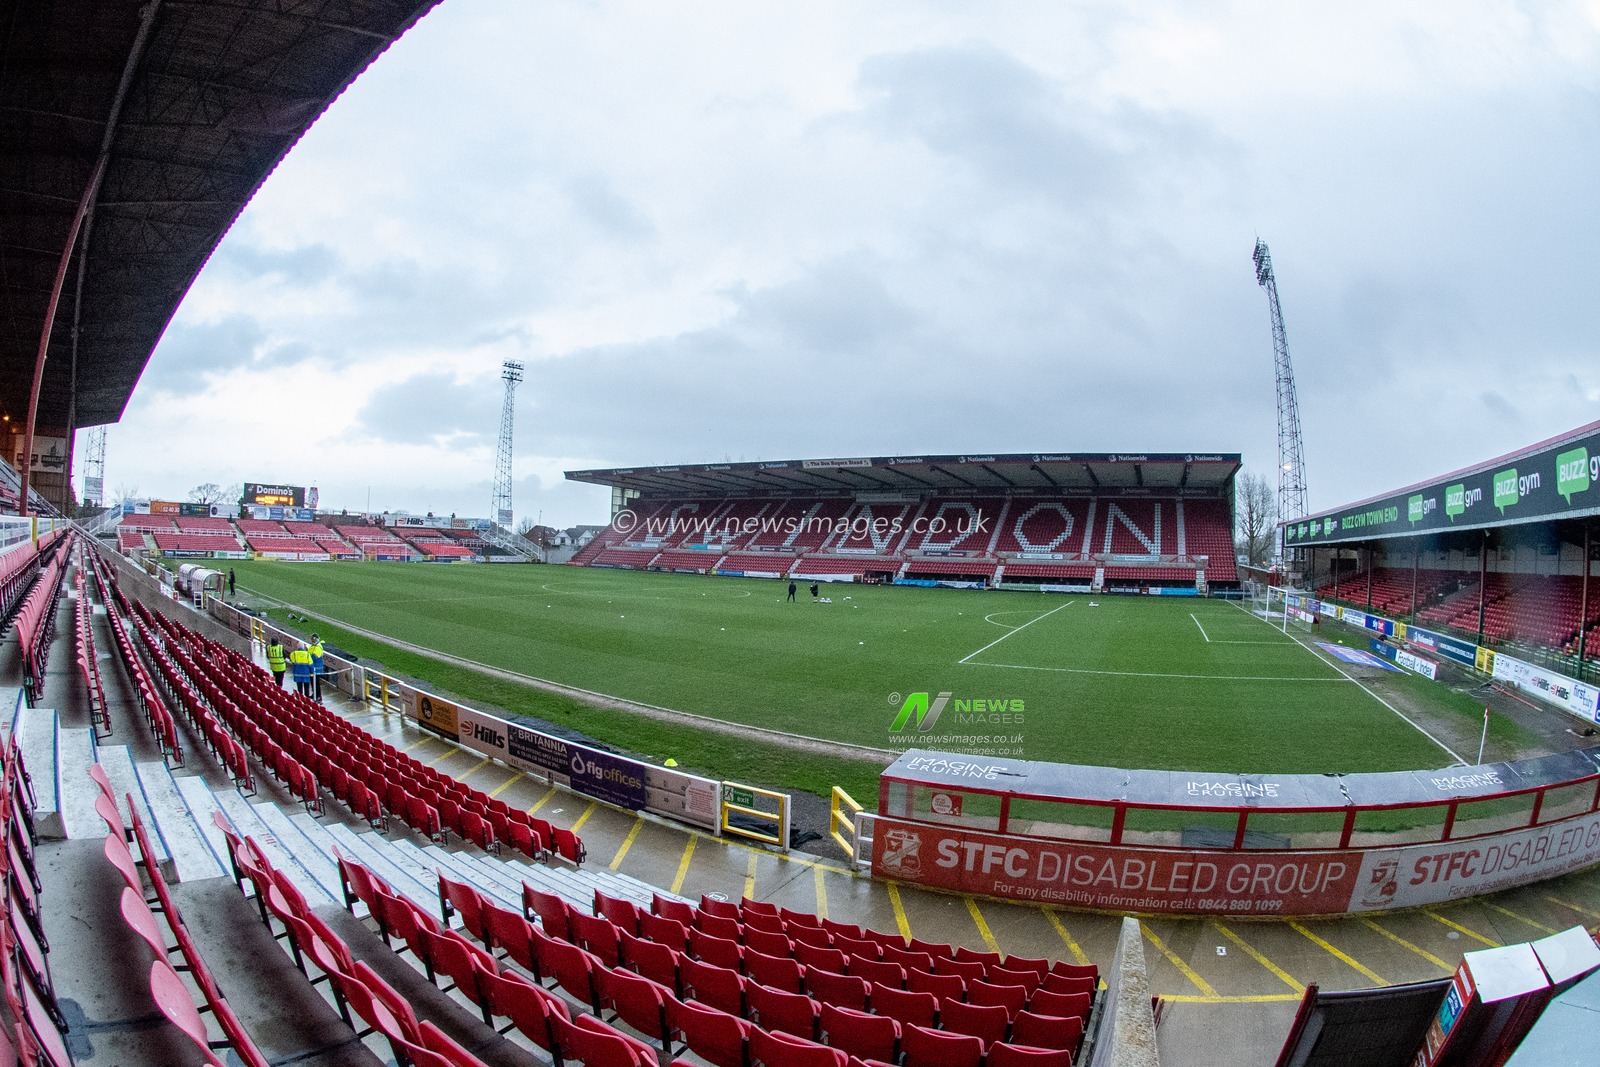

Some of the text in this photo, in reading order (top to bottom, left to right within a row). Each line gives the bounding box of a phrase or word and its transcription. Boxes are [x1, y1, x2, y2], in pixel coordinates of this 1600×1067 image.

[1559, 459, 1586, 482] BUZZ
[256, 485, 293, 496] Domino's
[1495, 472, 1540, 497] BUZZ gym
[1409, 498, 1436, 514] BUZZ gym
[1447, 487, 1482, 507] BUZZ gym
[1341, 506, 1398, 530] BUZZ GYM TOWN END
[1398, 652, 1433, 677] Football Index
[1537, 677, 1550, 691] Hills
[1555, 683, 1569, 700] Hills
[1573, 684, 1586, 699] first
[474, 723, 505, 749] Hills
[518, 730, 568, 754] BRITANNIA
[907, 763, 1000, 780] CRUISING
[911, 757, 1004, 774] IMAGINE
[1187, 782, 1276, 791] IMAGINE
[1431, 771, 1500, 786] IMAGINE
[1437, 778, 1504, 791] CRUISING
[1409, 849, 1480, 885] STFC
[1481, 827, 1584, 875] DISABLED
[935, 838, 1347, 895] STFC DISABLED GROUP
[993, 881, 1284, 910] For any disability information call: 0844 880 1099
[1448, 885, 1461, 896] For
[1464, 884, 1478, 894] any
[1480, 877, 1512, 892] disability
